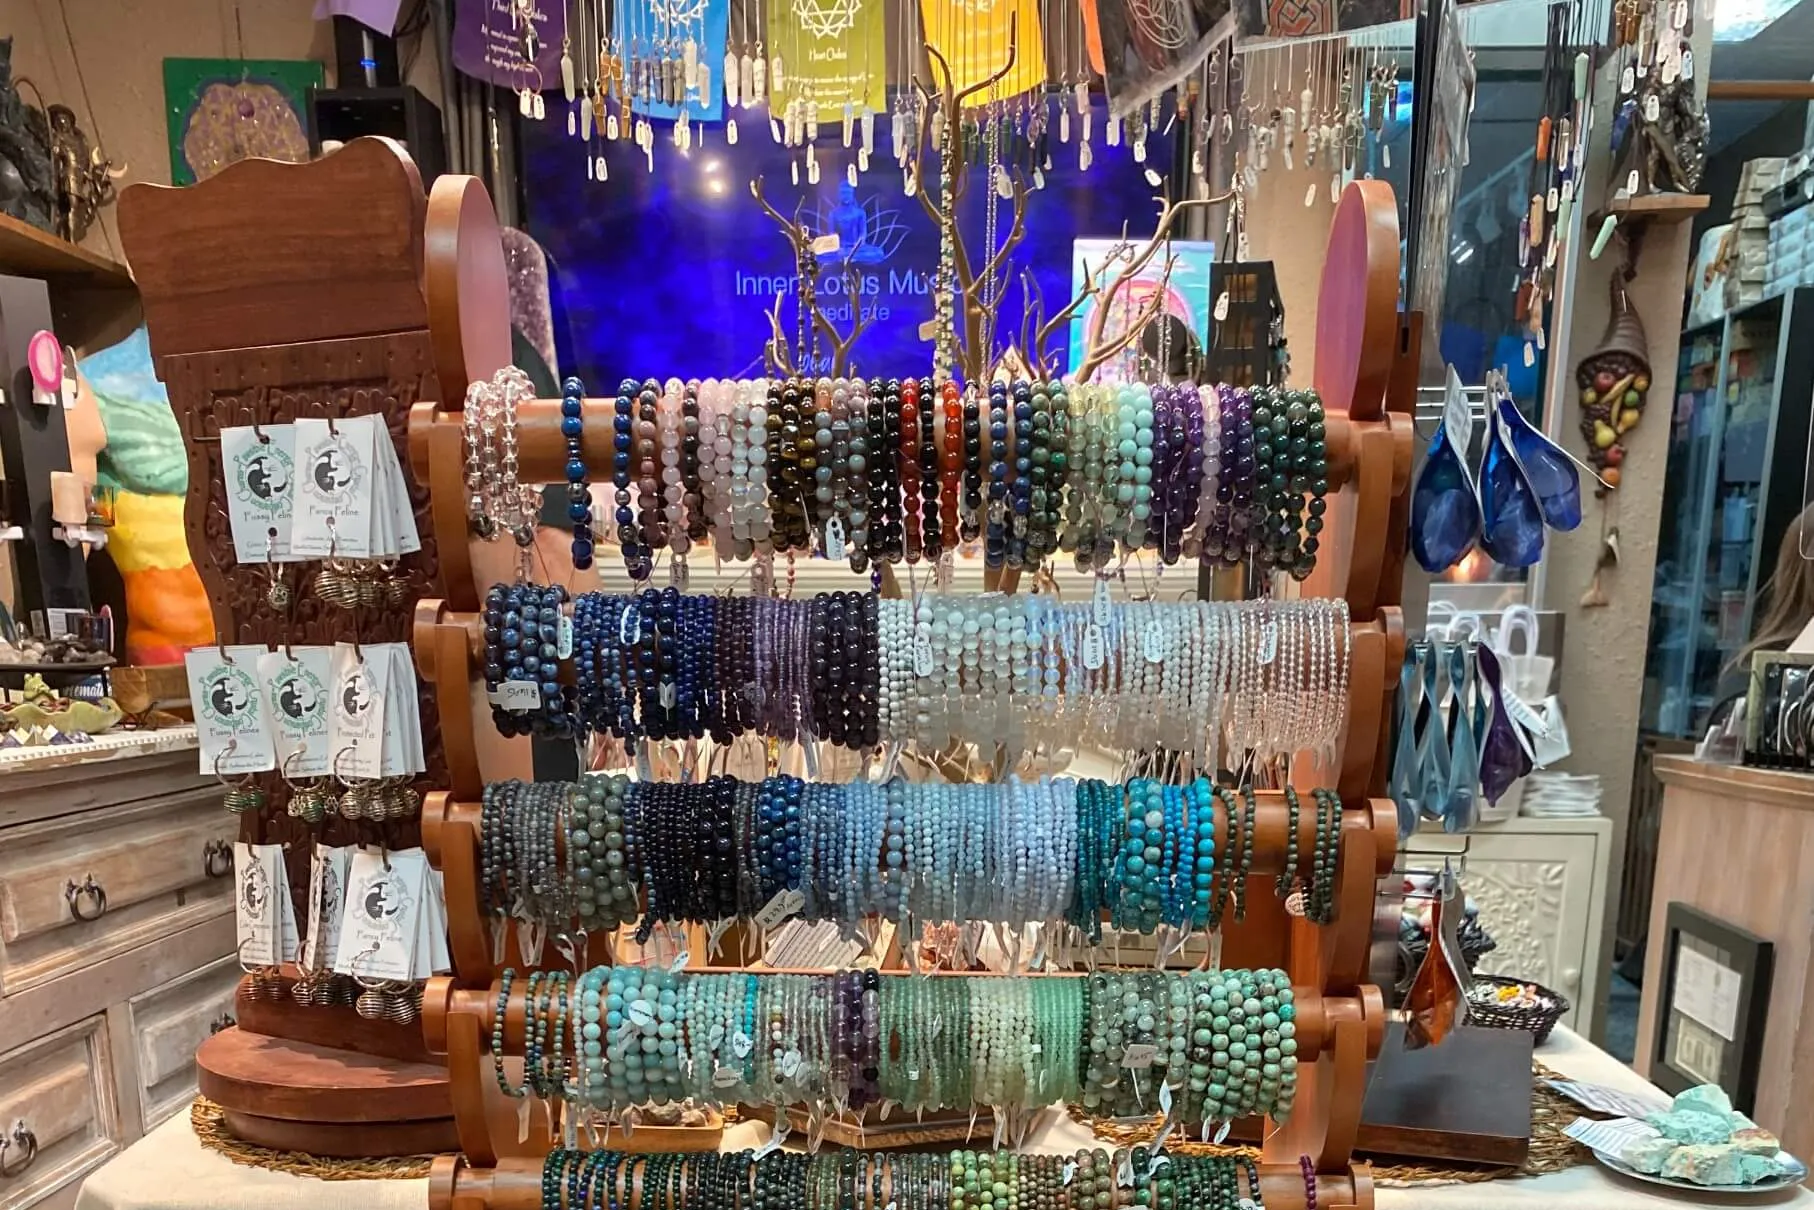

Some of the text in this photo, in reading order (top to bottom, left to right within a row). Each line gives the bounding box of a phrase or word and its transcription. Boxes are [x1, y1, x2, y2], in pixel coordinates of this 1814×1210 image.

[736, 269, 964, 296] Inner Lotus Musc
[334, 504, 359, 517] Feline
